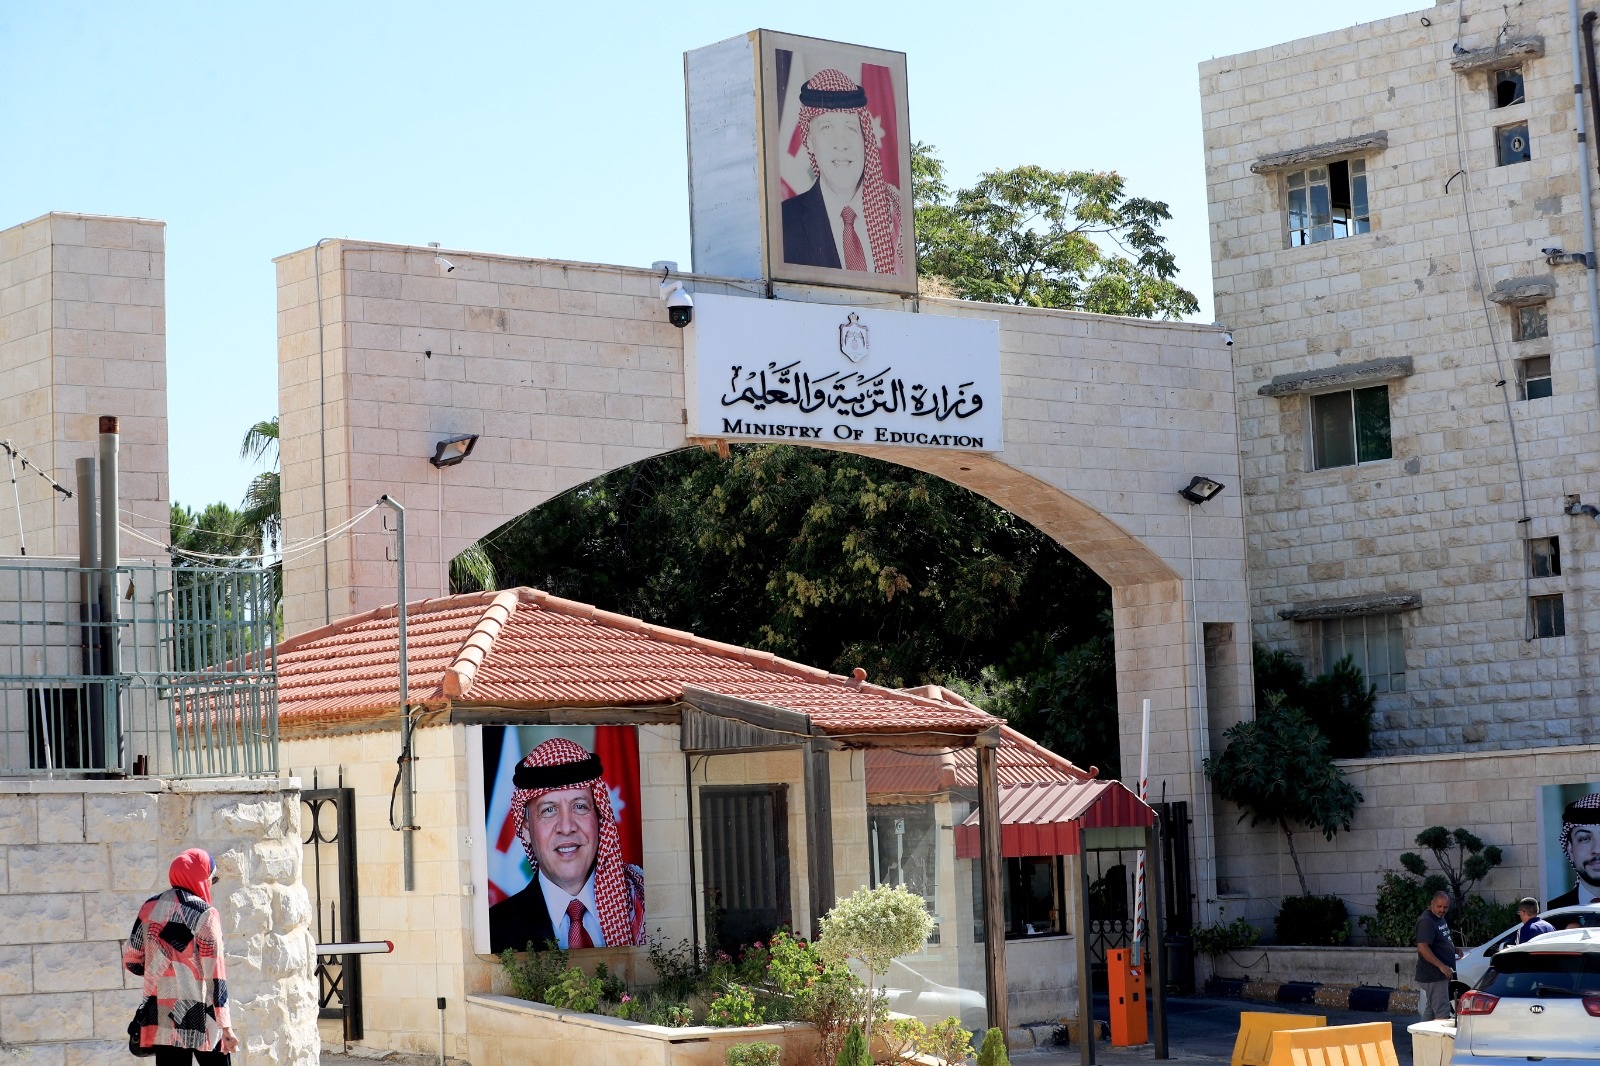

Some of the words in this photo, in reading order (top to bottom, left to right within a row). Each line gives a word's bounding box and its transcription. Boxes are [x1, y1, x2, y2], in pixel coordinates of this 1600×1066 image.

[722, 418, 824, 438] MINISTRY
[833, 424, 864, 440] OF
[874, 427, 984, 447] EDUCATION
